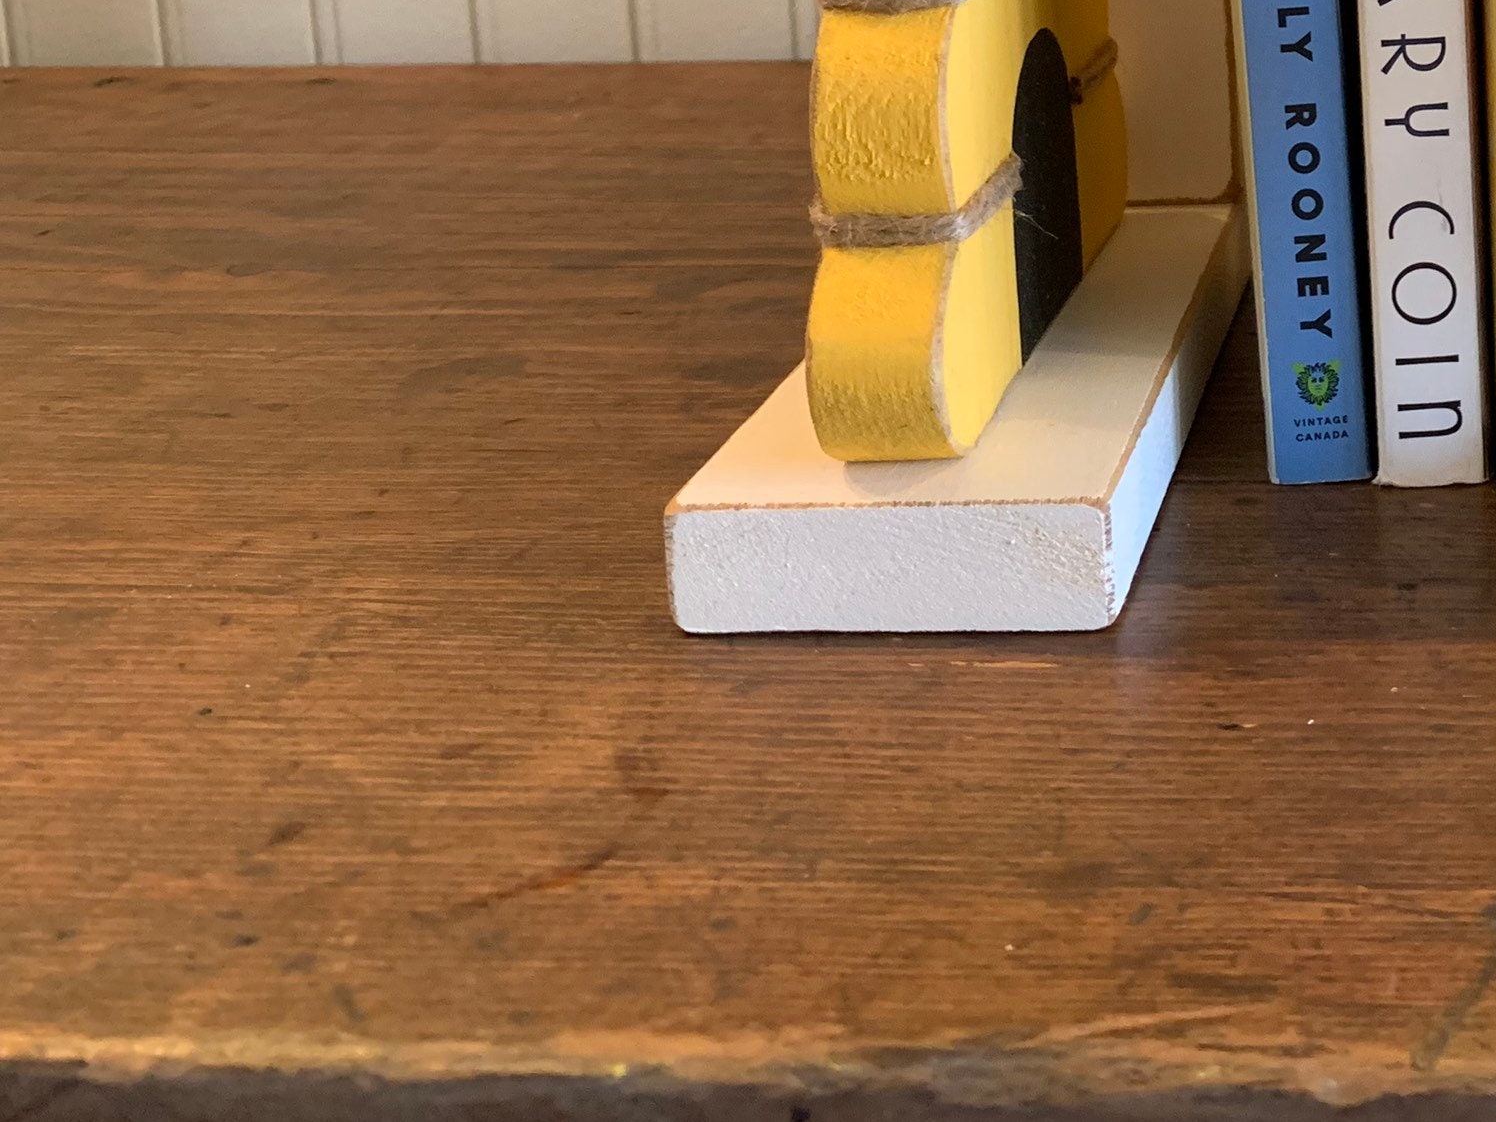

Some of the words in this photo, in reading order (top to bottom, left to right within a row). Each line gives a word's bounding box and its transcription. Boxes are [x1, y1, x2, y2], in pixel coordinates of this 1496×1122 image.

[1283, 102, 1334, 338] ROONEY
[1293, 413, 1349, 427] VINTAGE
[1295, 429, 1349, 442] CANADA
